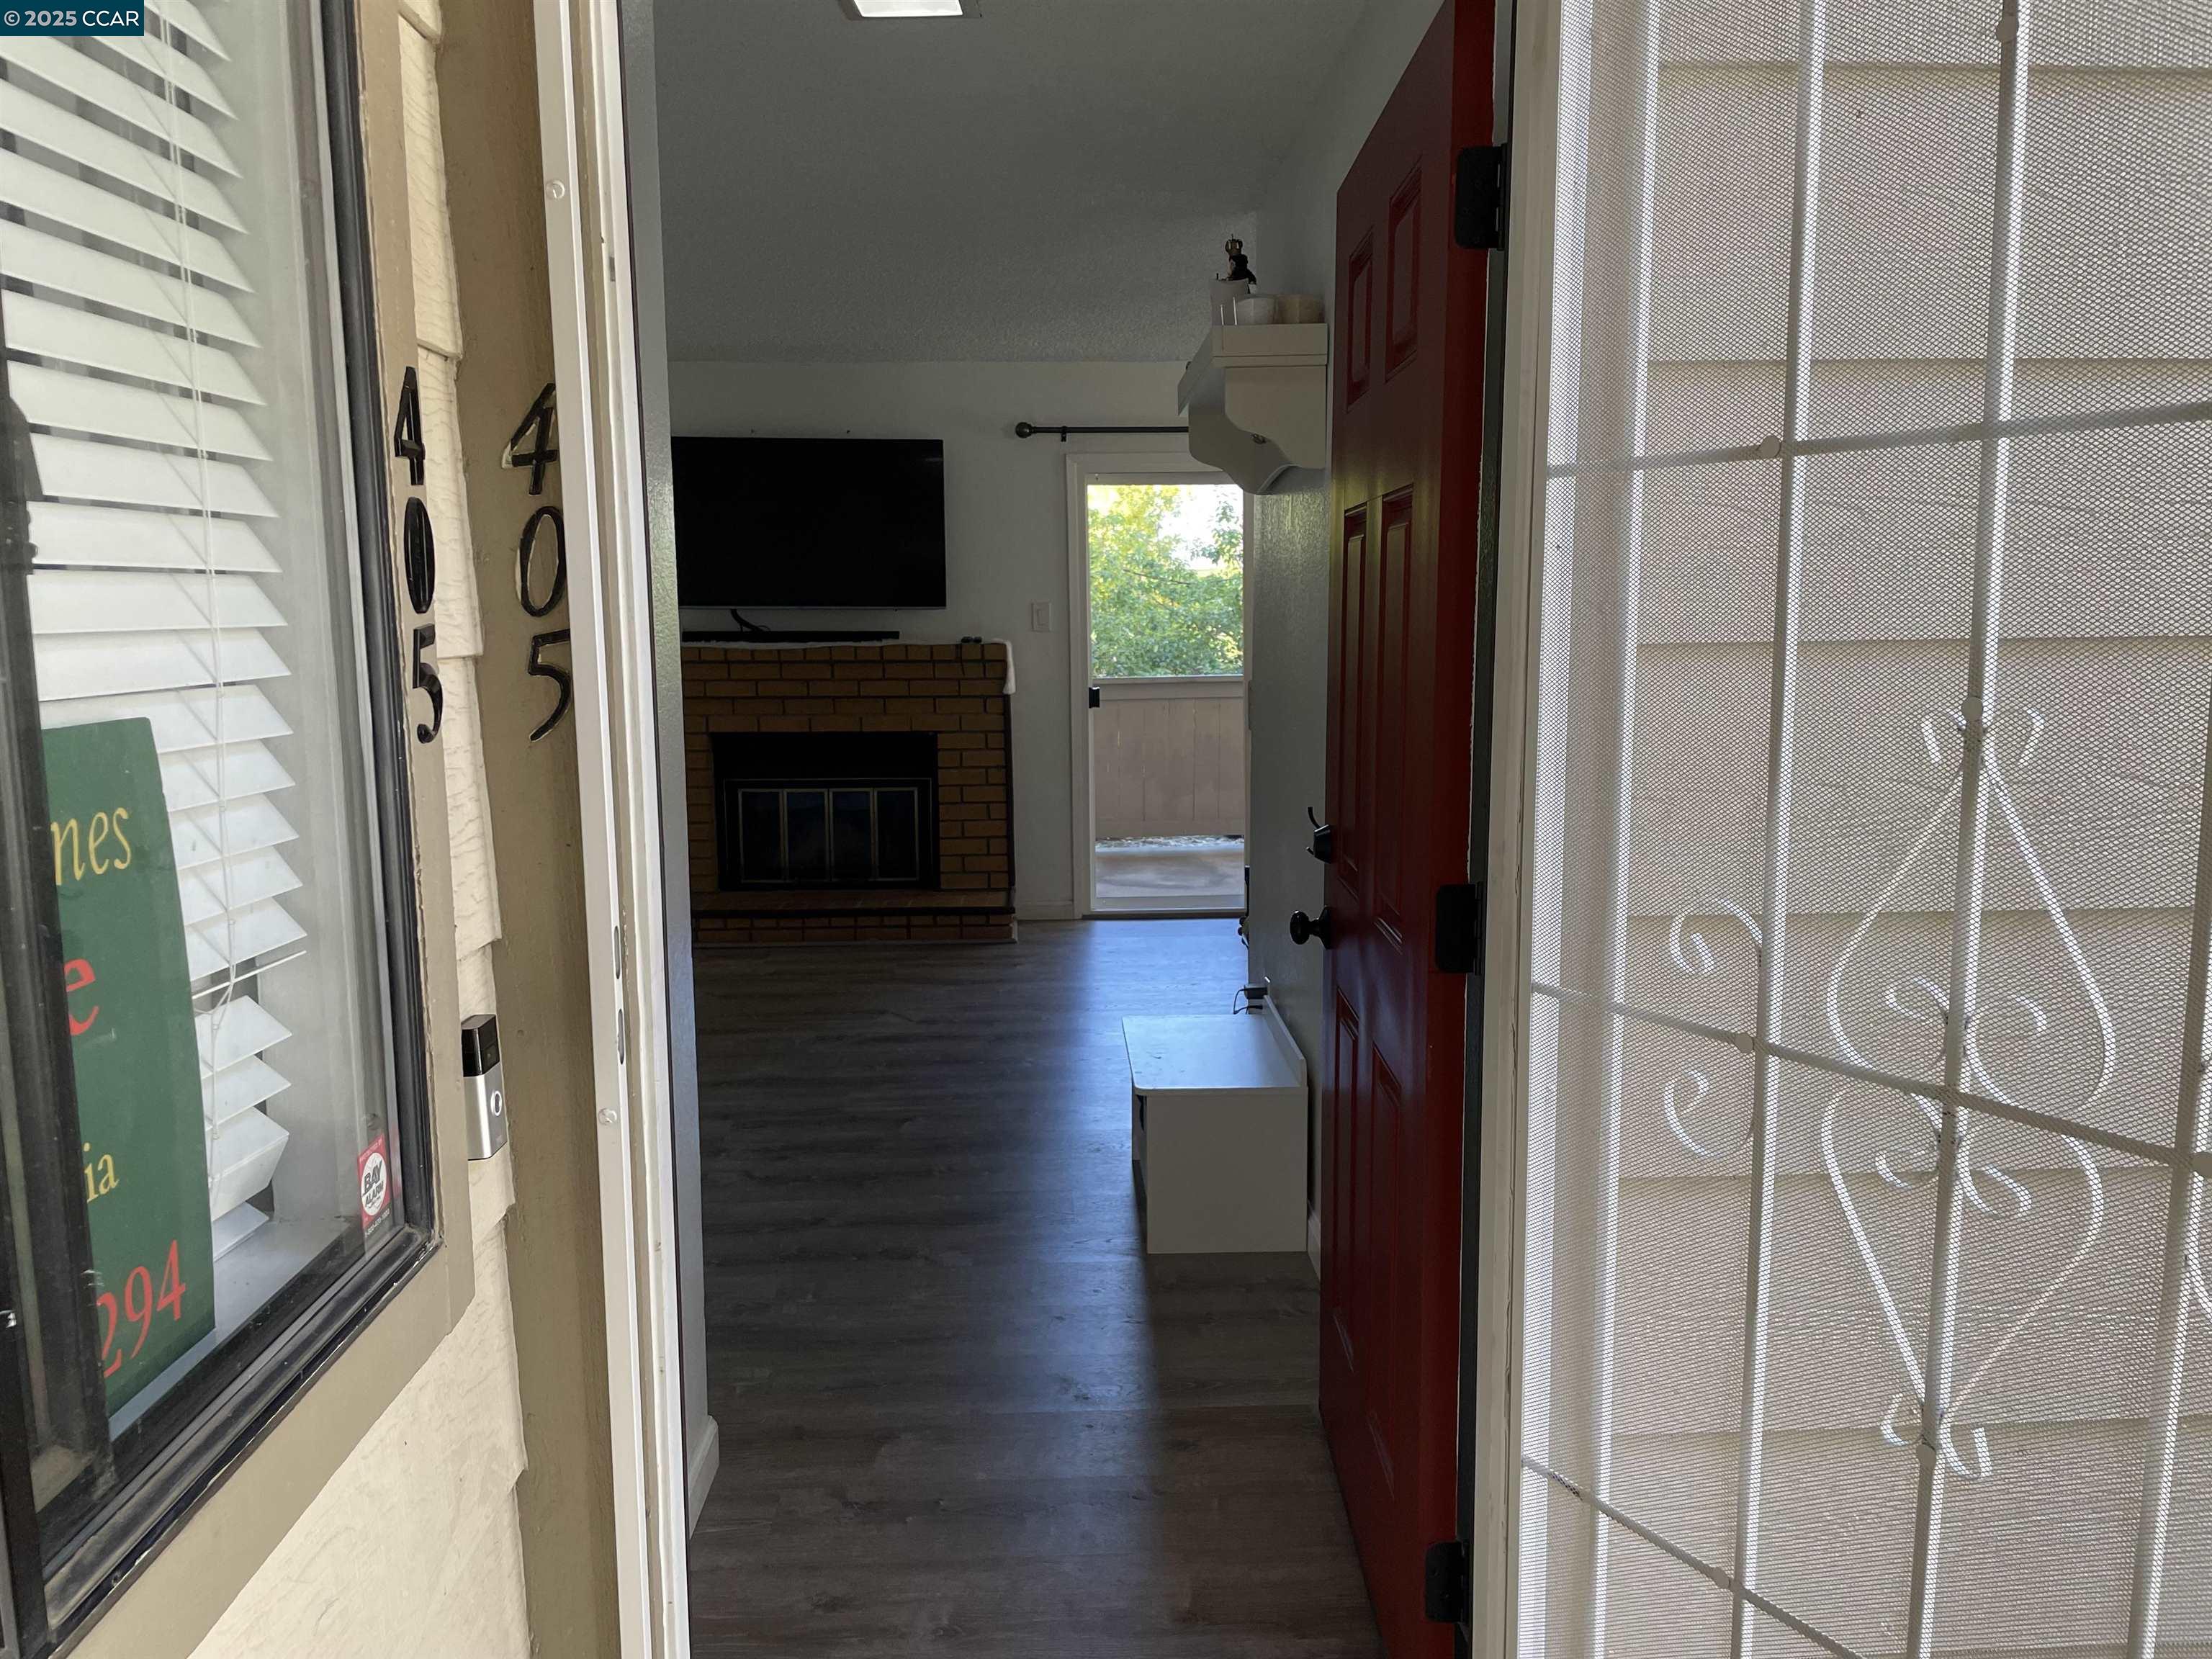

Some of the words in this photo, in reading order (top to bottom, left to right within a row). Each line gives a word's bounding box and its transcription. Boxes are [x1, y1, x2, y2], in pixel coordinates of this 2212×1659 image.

[395, 367, 443, 744] 405
[508, 382, 572, 742] 405
[363, 1160, 382, 1195] BAY
[365, 1181, 384, 1208] ALARM
